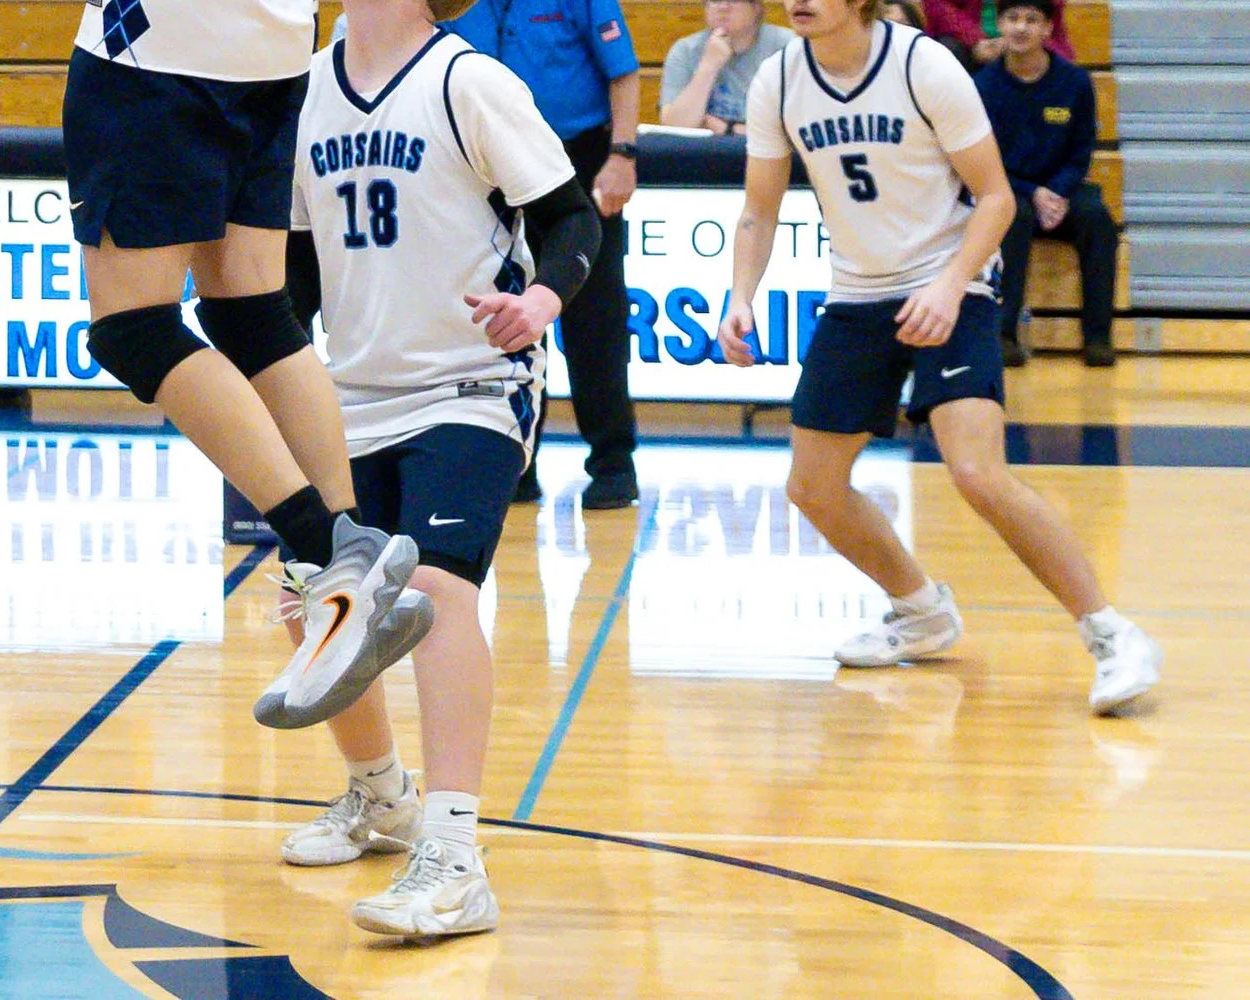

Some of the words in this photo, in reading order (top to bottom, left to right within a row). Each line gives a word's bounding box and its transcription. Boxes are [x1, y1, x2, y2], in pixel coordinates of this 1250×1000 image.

[310, 129, 426, 178] CORSAIRS
[798, 113, 905, 152] CORSAIRS
[839, 153, 879, 202] 5
[335, 178, 399, 250] 18
